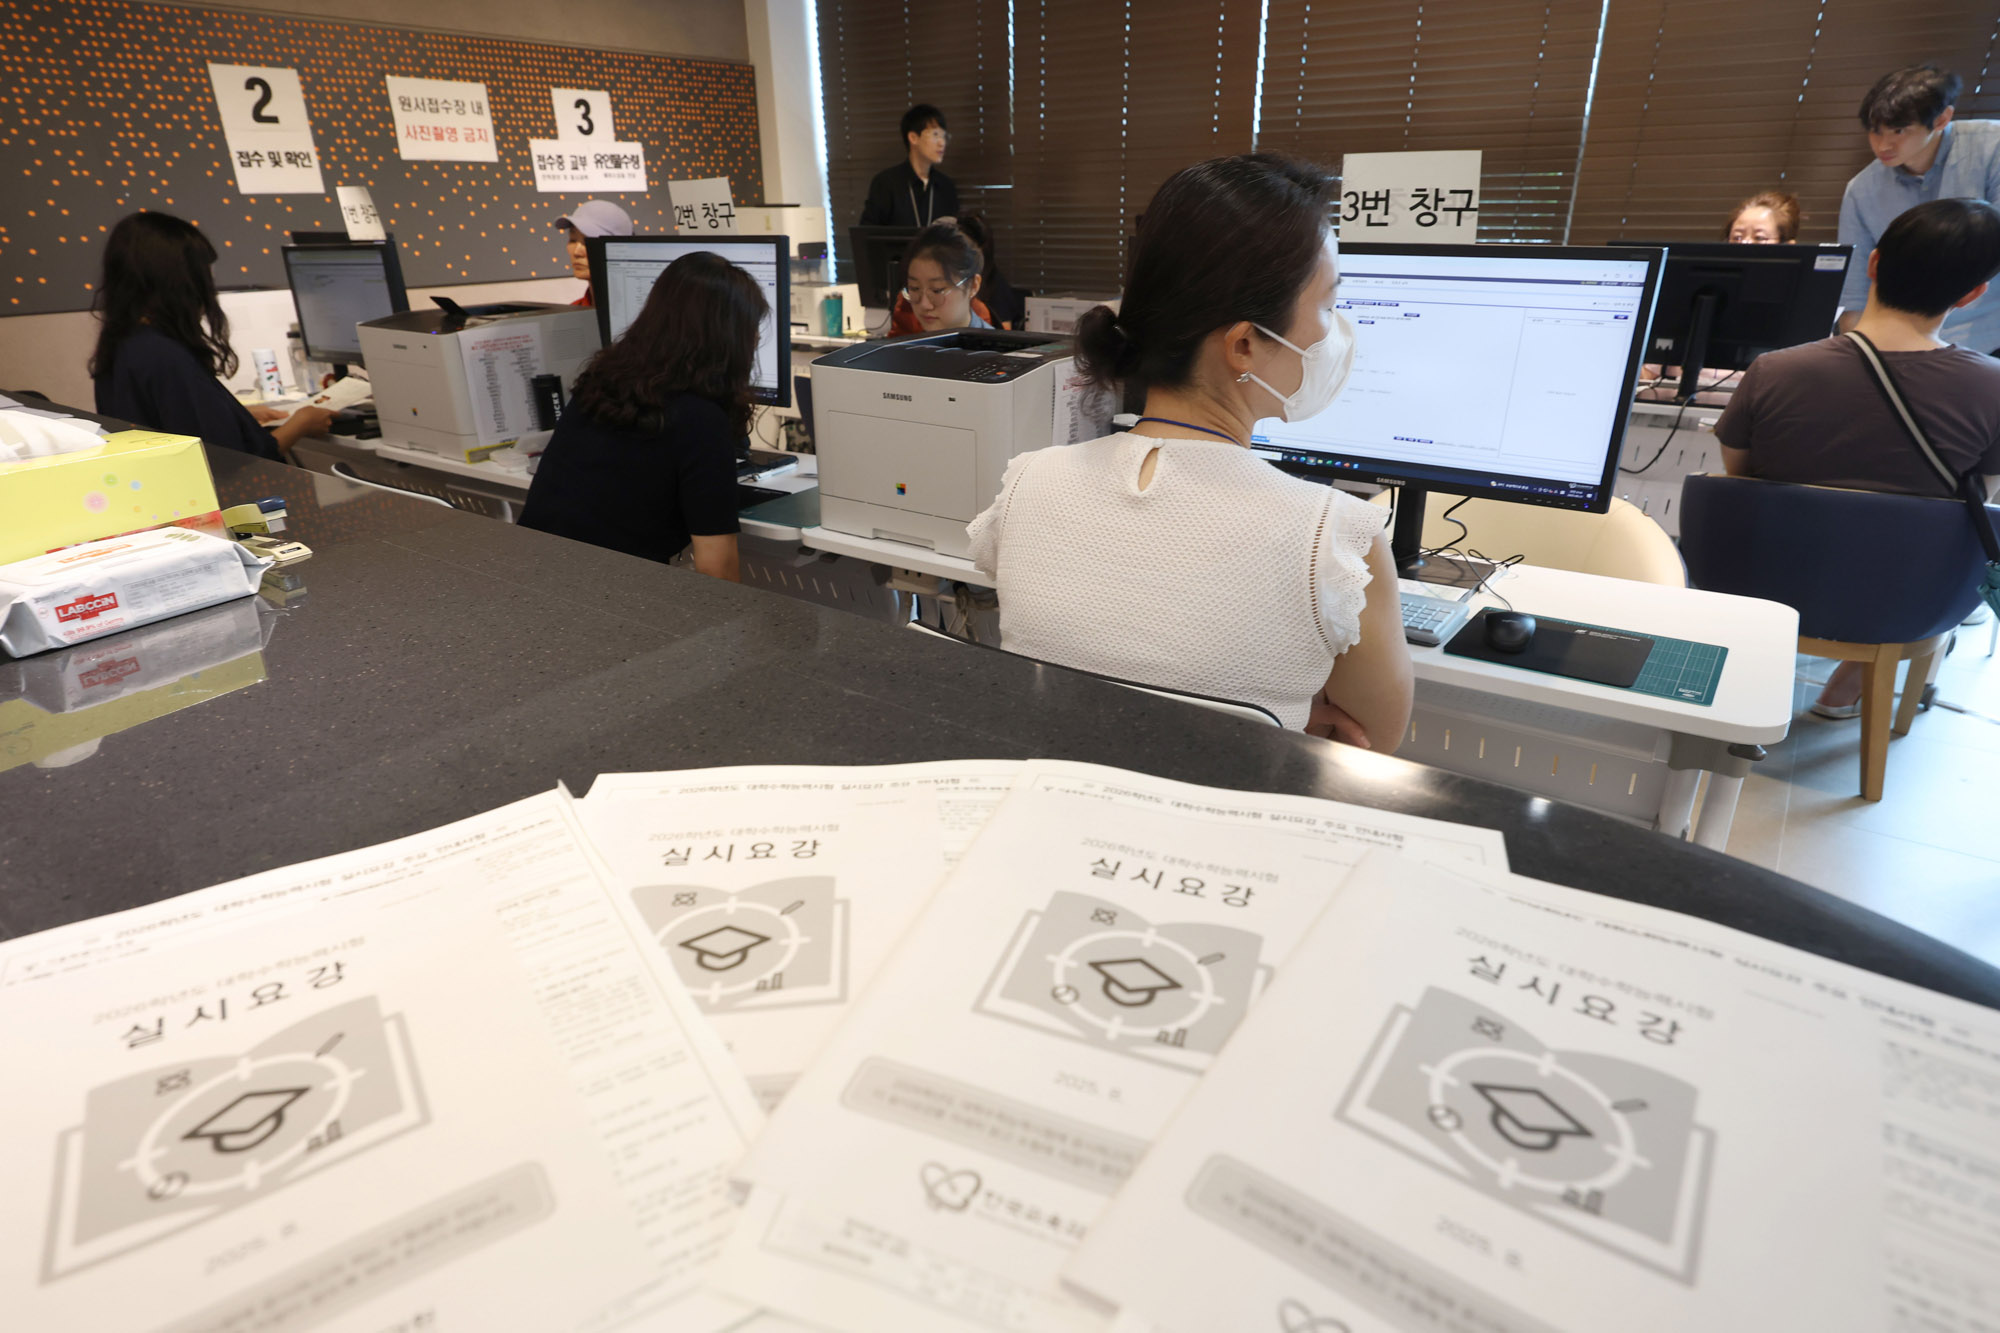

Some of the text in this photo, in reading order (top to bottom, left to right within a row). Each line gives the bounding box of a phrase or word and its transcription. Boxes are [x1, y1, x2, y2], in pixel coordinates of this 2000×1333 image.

[244, 76, 280, 124] 2
[471, 100, 485, 116] 내
[574, 98, 595, 136] 3
[405, 124, 489, 143] 사진촬영 금지
[236, 150, 313, 168] 접수 및 확인
[593, 153, 641, 170] 유인물수령
[674, 202, 736, 229] 2번 창구
[1342, 187, 1478, 228] 3번 창구
[551, 391, 562, 421] UCKS
[882, 392, 913, 402] SAMSUNG
[660, 838, 822, 867] 실시요강
[1089, 856, 1256, 908] 실시요강
[121, 961, 347, 1049] 실시요강
[1468, 953, 1686, 1047] 실시요강
